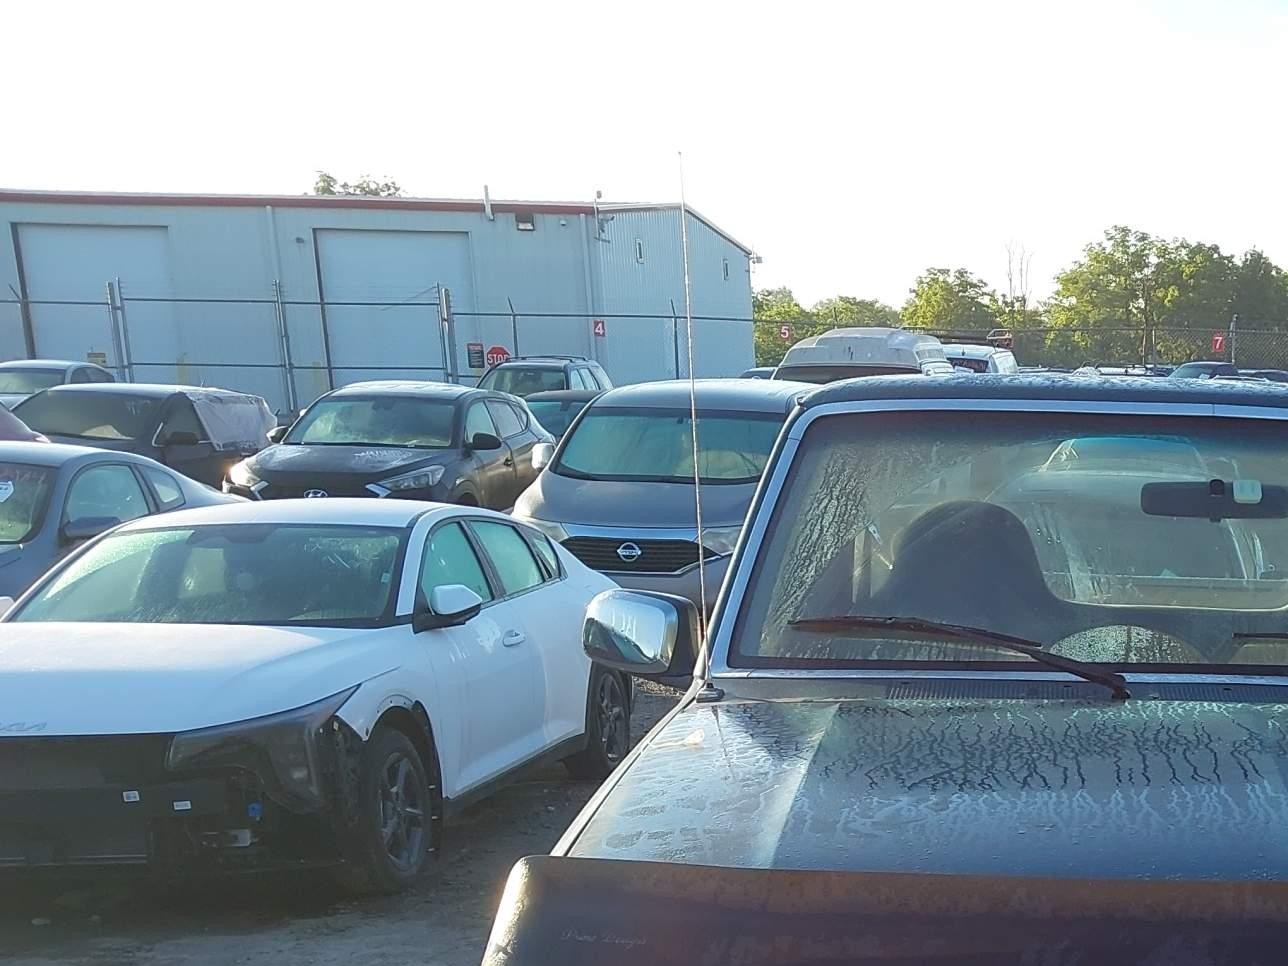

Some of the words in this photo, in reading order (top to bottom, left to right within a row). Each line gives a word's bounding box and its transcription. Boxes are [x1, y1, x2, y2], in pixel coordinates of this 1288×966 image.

[595, 322, 604, 335] 4
[780, 325, 789, 339] 5
[1214, 336, 1223, 349] 7
